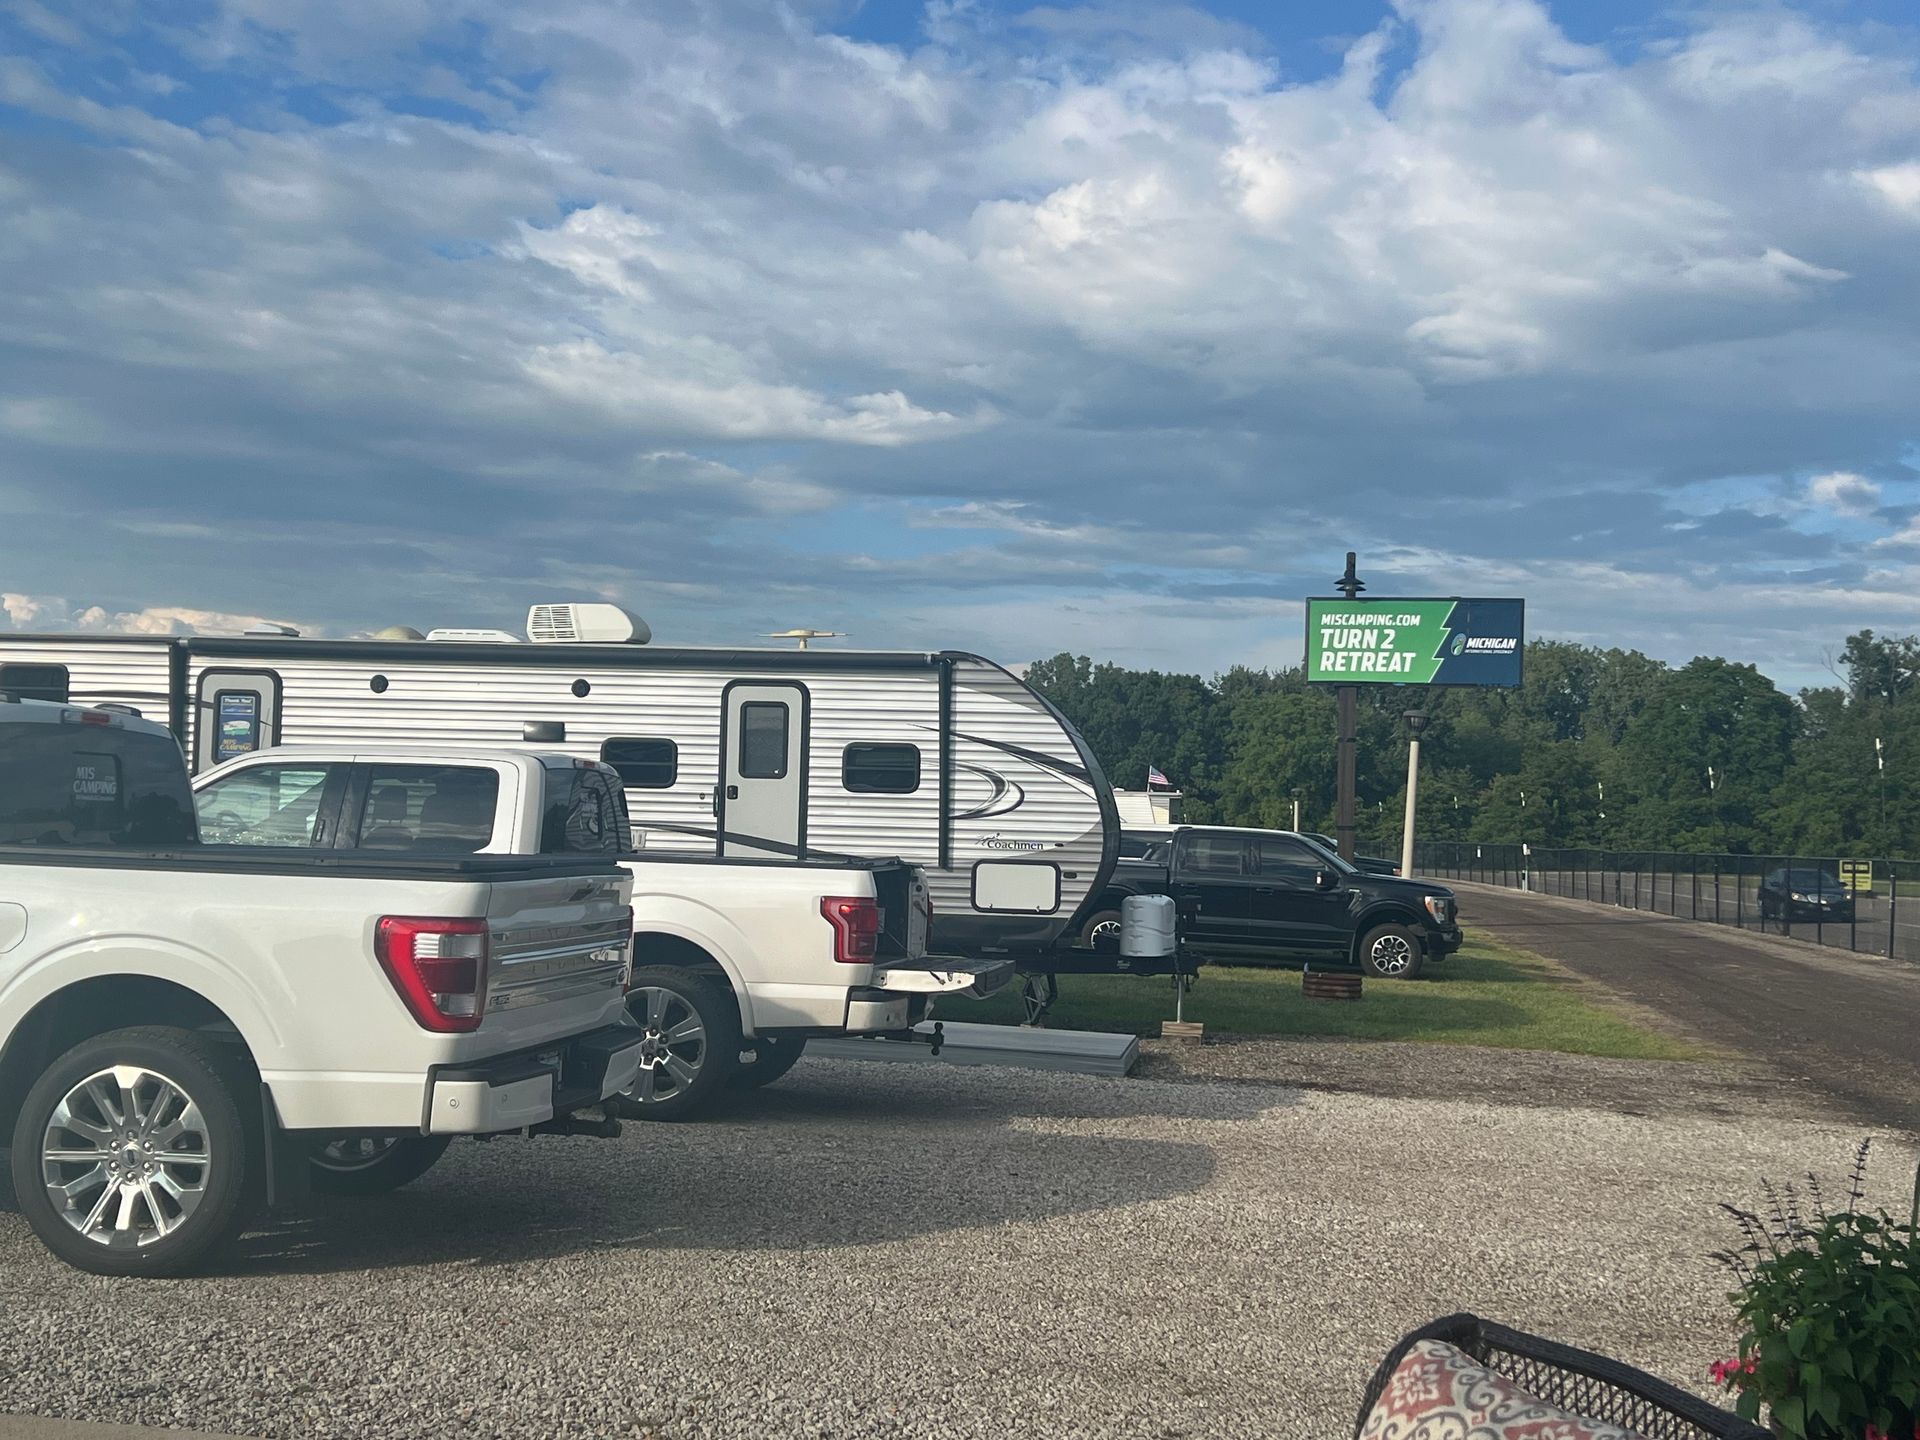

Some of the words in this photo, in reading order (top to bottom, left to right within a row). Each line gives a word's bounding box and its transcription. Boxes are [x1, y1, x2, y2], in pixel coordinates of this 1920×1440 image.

[1321, 613, 1421, 626] MISCAMPING.COM
[1320, 628, 1380, 649] TURN
[1380, 628, 1396, 649] 2
[1466, 637, 1517, 649] MICHIGAN
[1319, 651, 1416, 673] RETREAT
[75, 766, 96, 780] MIS
[73, 780, 117, 794] CAMPING
[987, 839, 1044, 850] Coachmen
